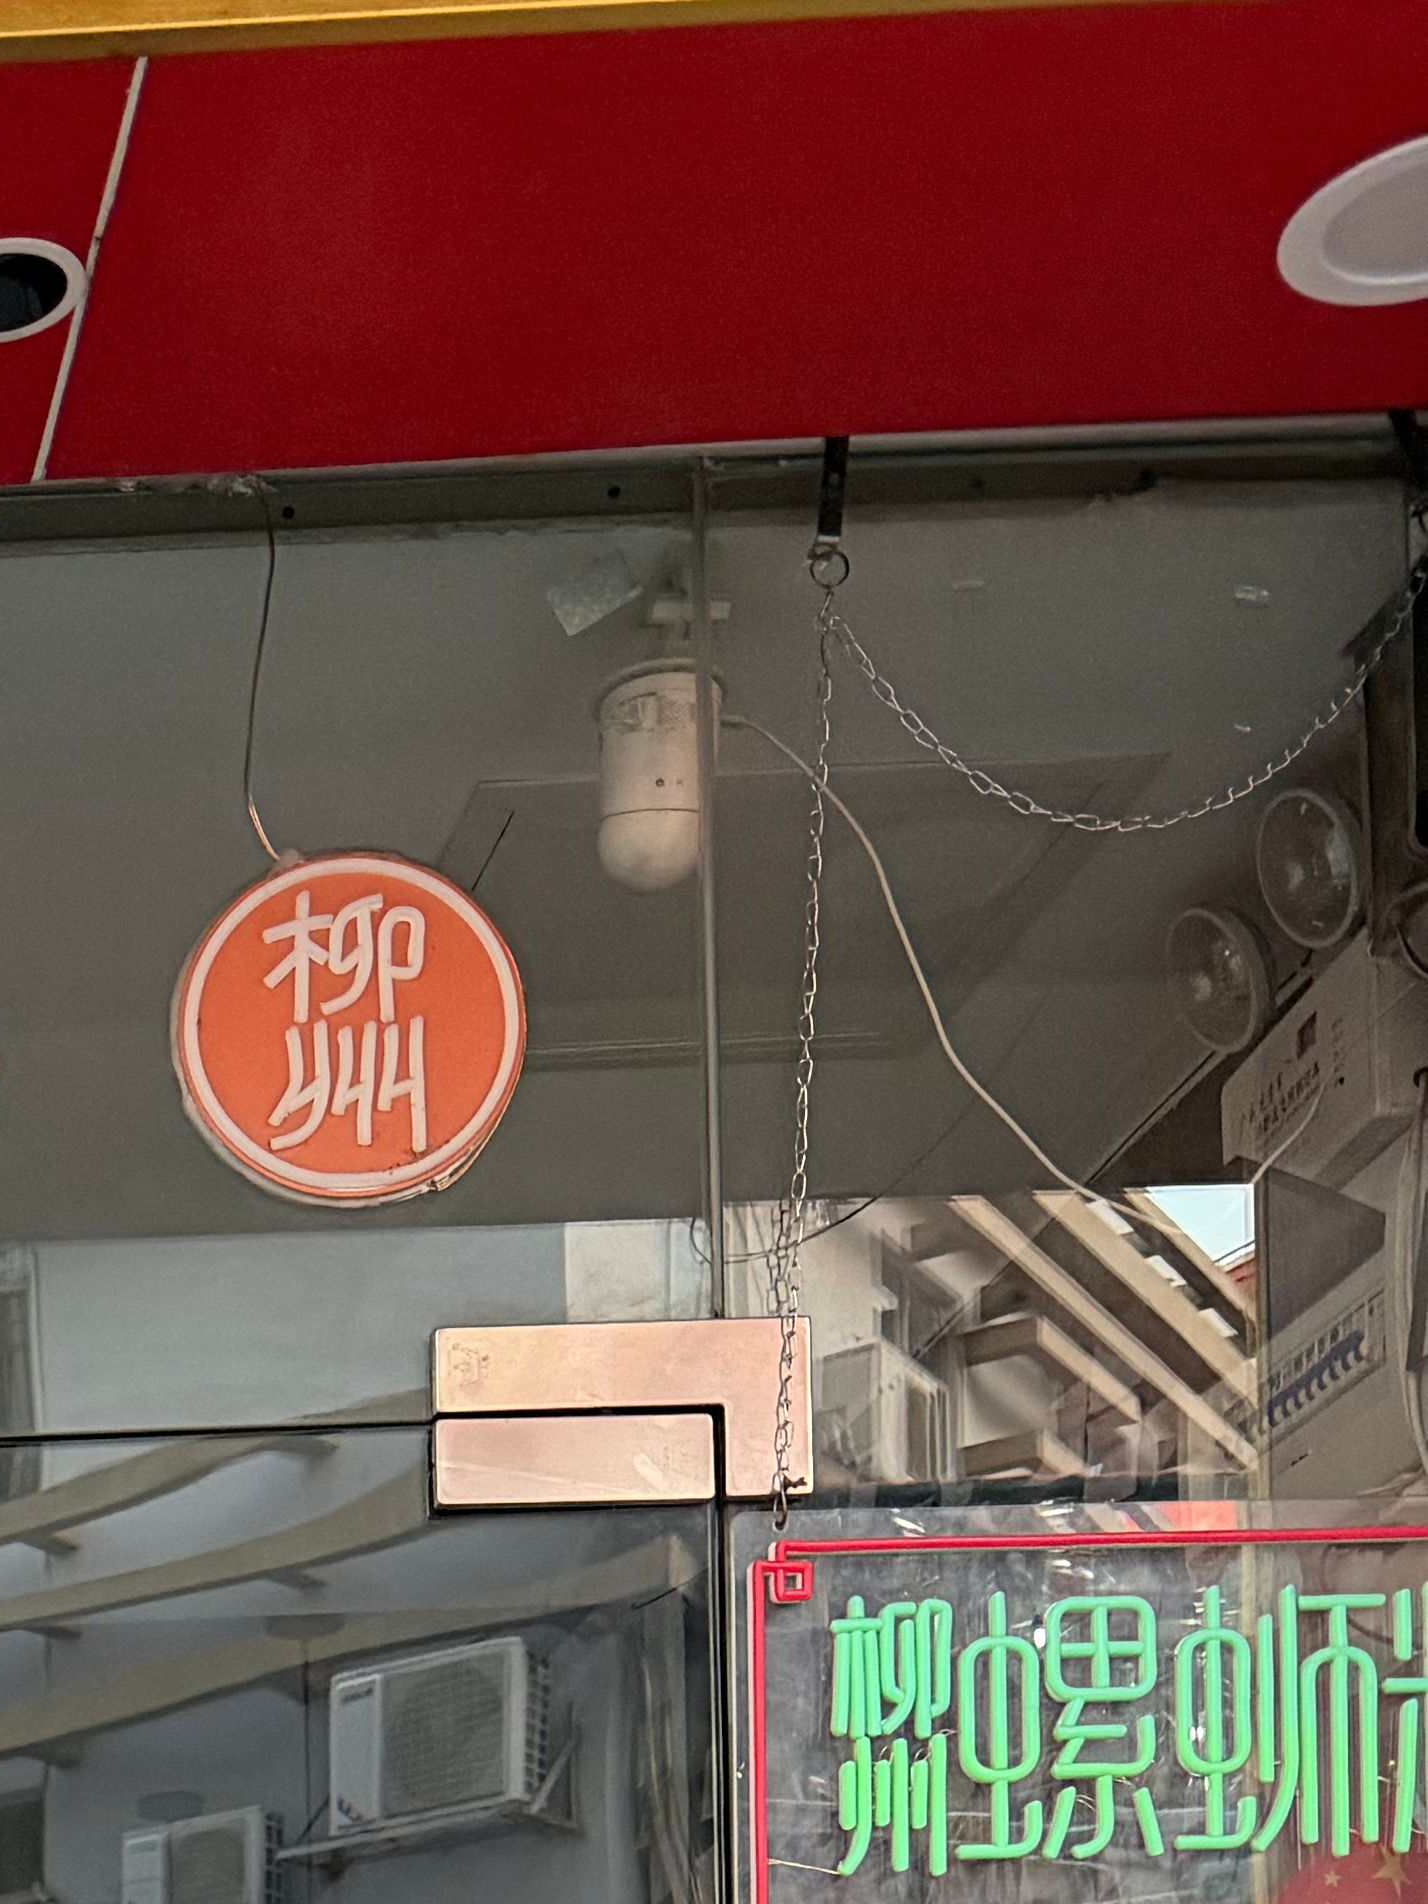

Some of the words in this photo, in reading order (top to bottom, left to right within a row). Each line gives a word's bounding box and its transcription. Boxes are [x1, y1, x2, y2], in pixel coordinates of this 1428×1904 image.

[260, 891, 430, 1157] 柳州
[831, 1594, 953, 1877] 柳州
[955, 1583, 1428, 1861] 螺蛳
